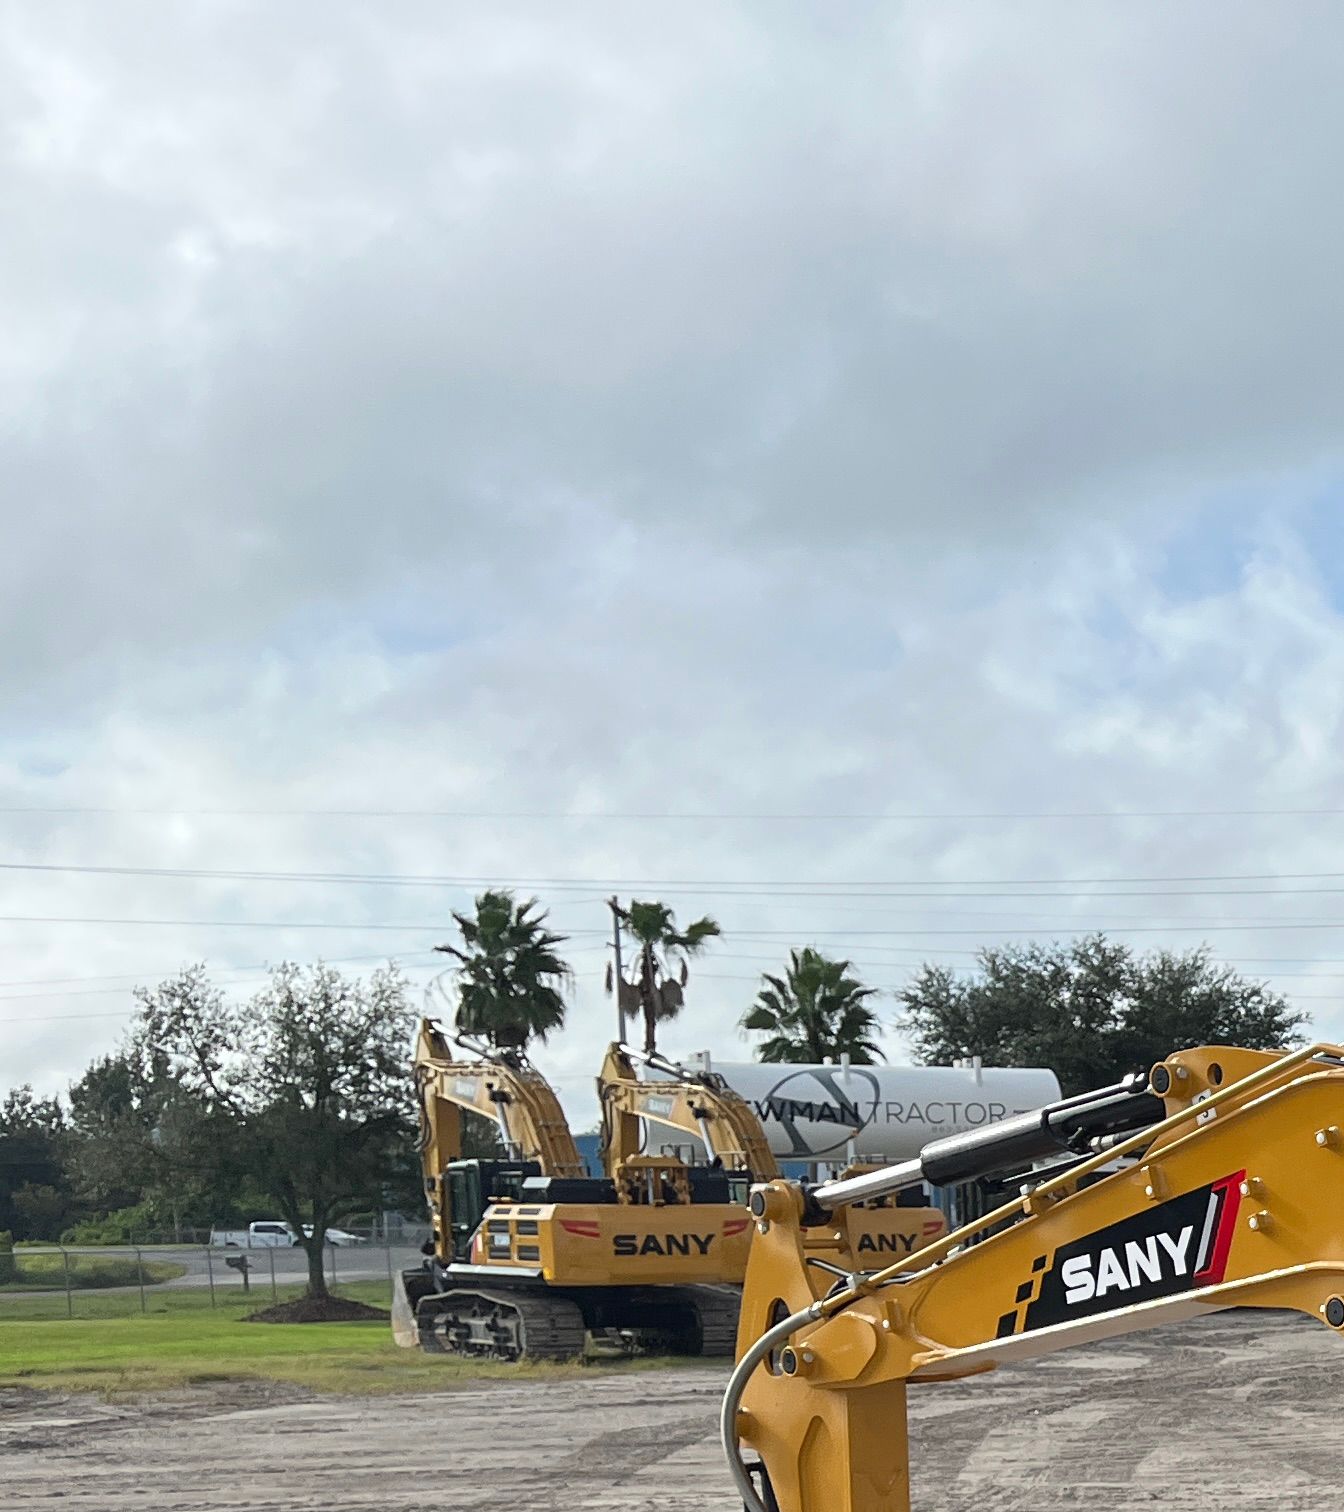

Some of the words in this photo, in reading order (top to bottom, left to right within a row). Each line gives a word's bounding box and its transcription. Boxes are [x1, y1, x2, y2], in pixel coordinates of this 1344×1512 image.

[745, 1100, 859, 1122] WMAN
[866, 1101, 1006, 1124] TRACTOR
[612, 1234, 715, 1256] SANY
[857, 1233, 918, 1252] ANY
[1061, 1225, 1194, 1305] SANY
